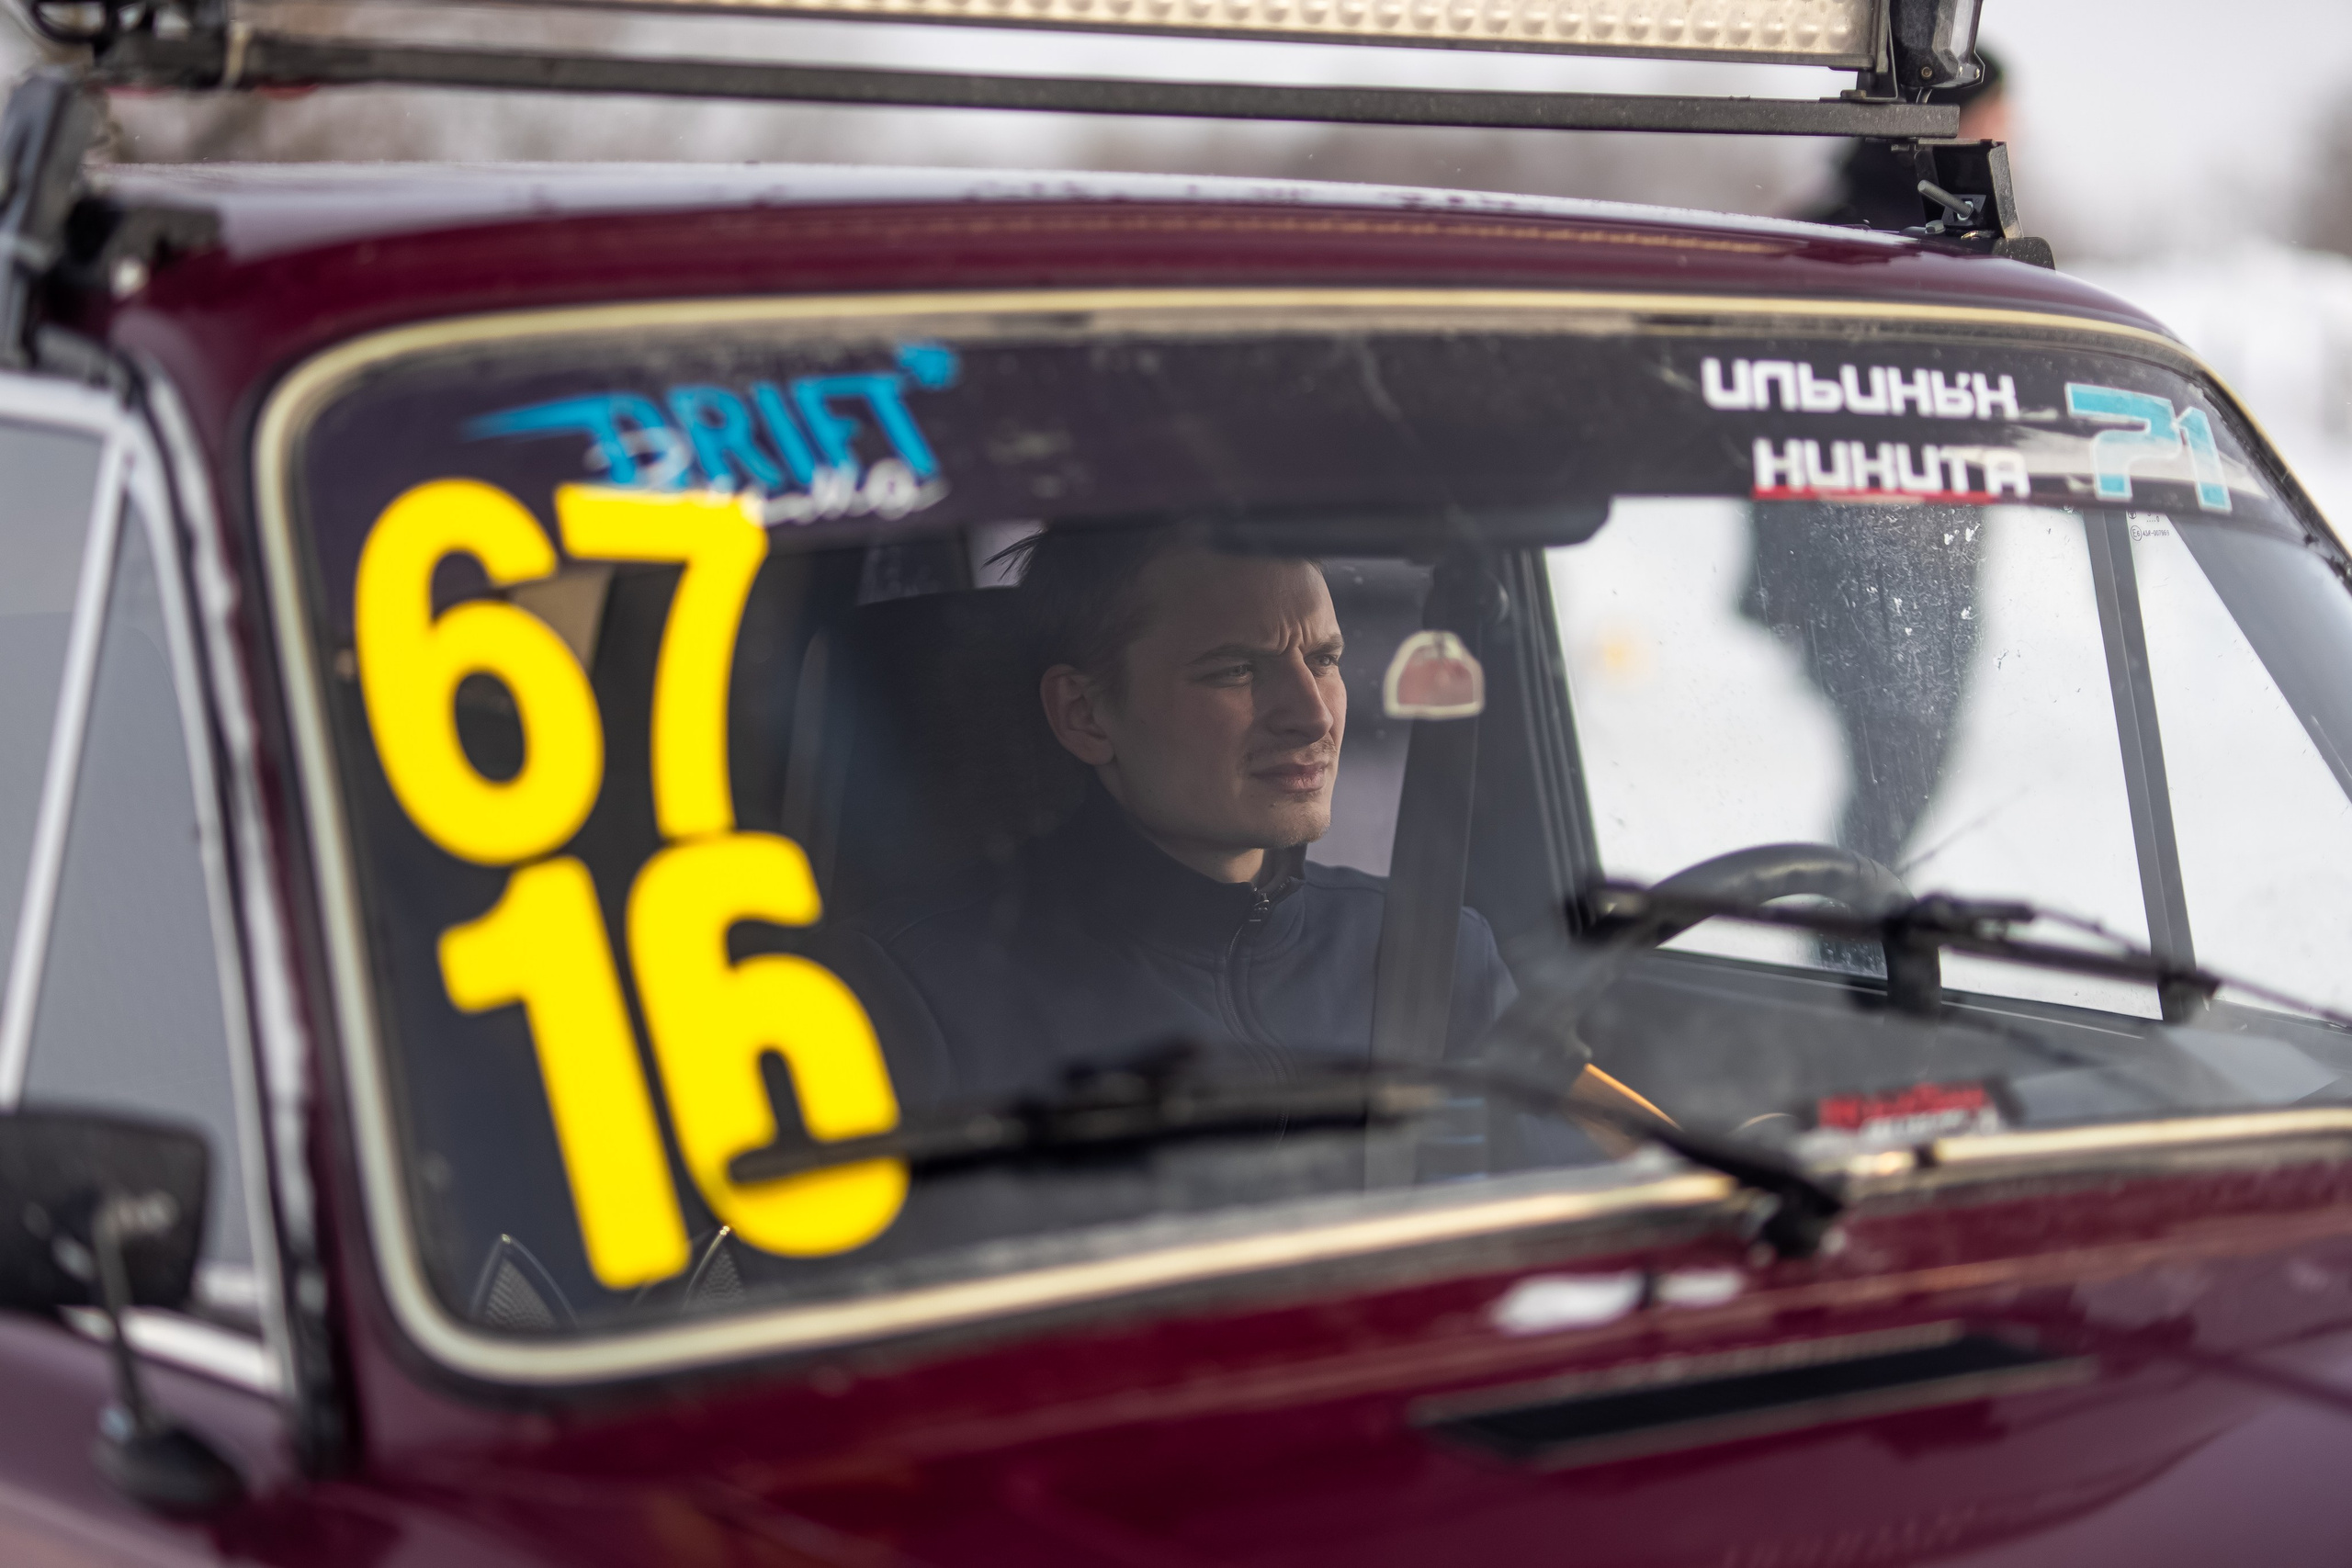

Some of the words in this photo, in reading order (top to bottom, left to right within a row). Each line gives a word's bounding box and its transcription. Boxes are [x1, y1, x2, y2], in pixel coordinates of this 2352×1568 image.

[467, 369, 941, 492] DRIFT
[2064, 381, 2233, 514] 71
[355, 478, 770, 866] 67
[438, 830, 910, 1290] 16
